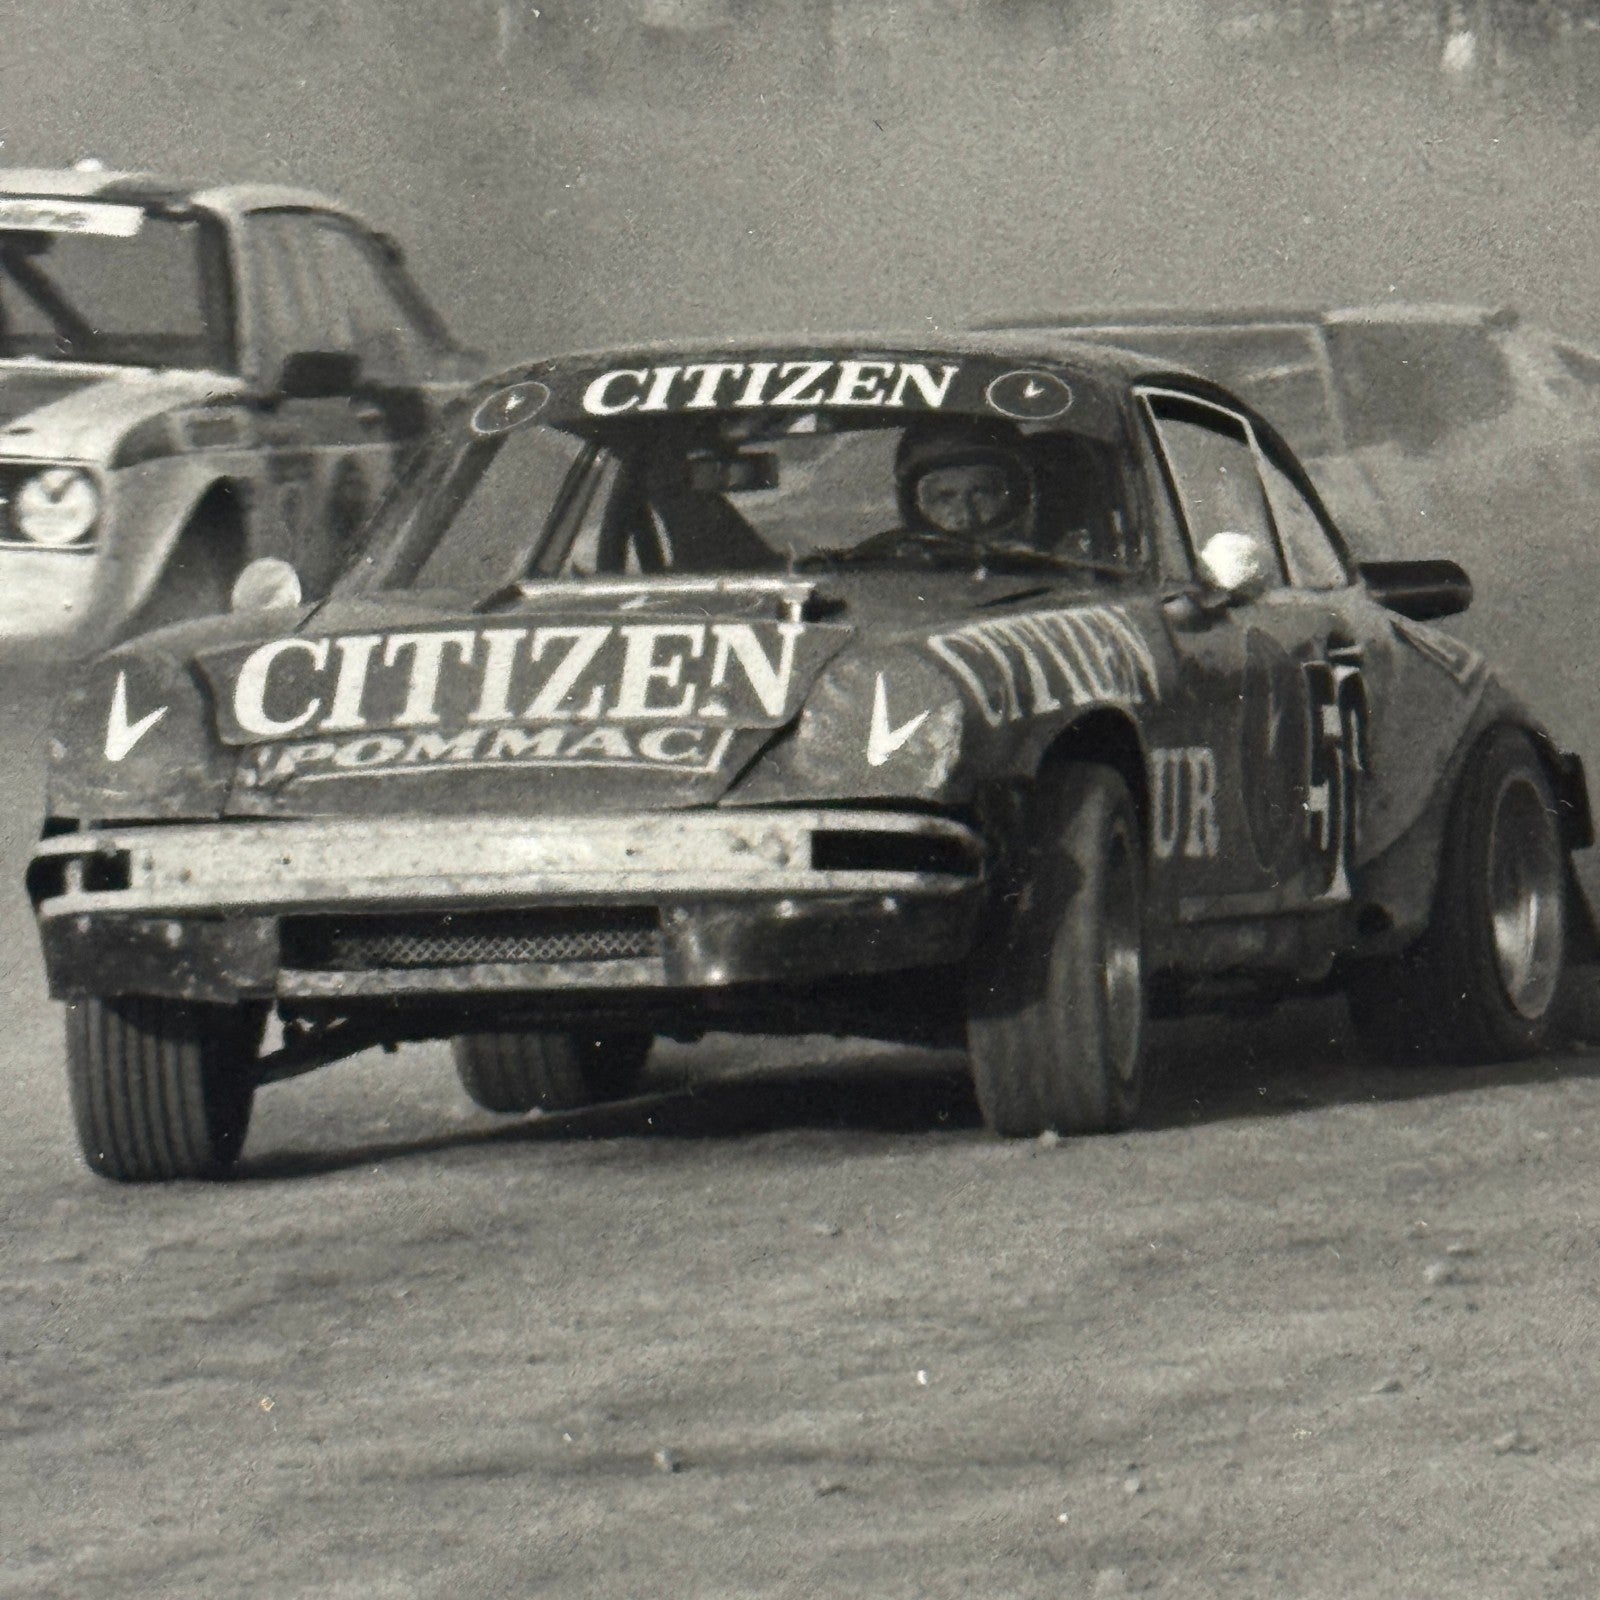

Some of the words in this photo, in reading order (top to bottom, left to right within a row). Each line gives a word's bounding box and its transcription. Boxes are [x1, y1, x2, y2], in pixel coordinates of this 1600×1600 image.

[582, 361, 960, 415] CITIZEN
[234, 623, 805, 738] CITIZEN
[267, 726, 706, 777] POMMAC
[1150, 746, 1220, 858] UR
